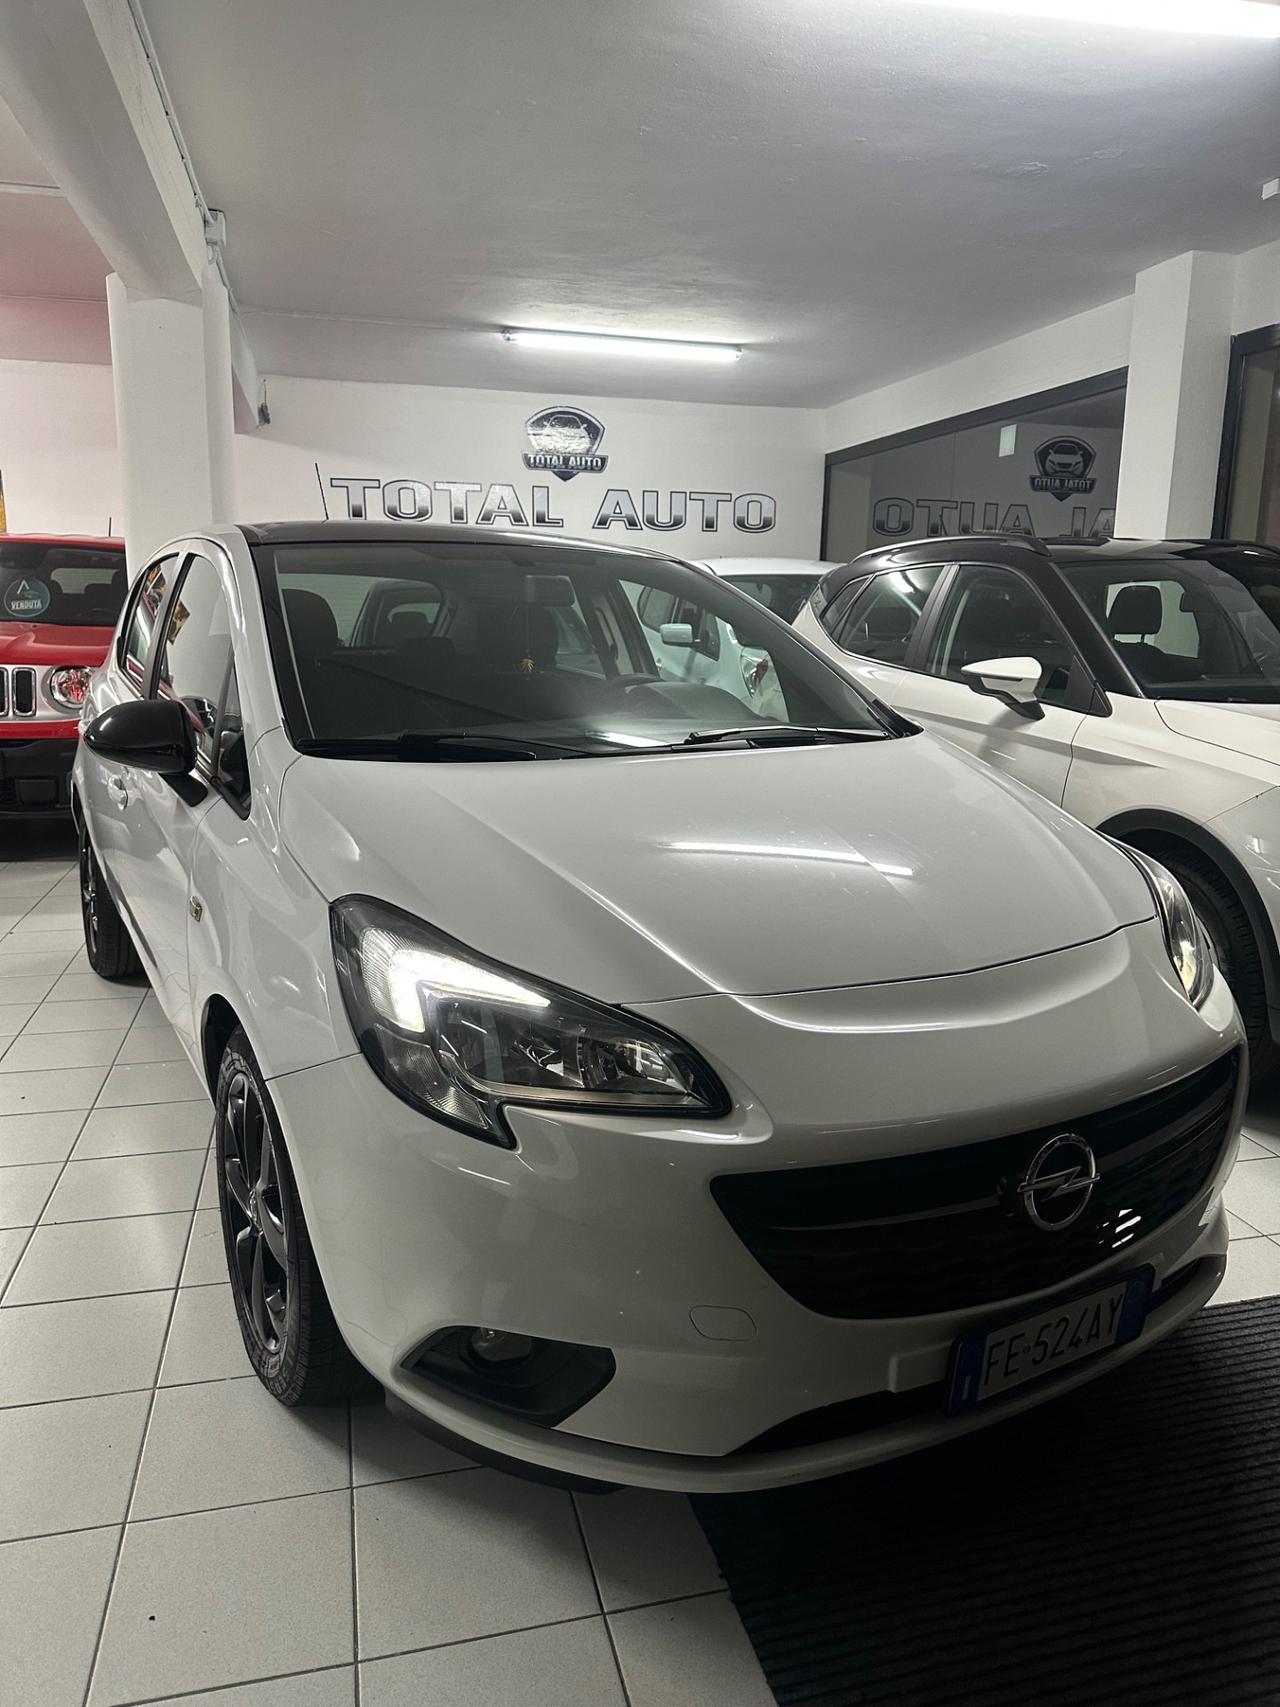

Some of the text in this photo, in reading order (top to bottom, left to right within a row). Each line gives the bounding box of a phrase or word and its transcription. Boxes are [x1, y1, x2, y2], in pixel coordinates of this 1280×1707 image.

[527, 454, 602, 470] TOTAL AUTO
[330, 478, 777, 534] TOTAL AUTO
[11, 599, 42, 610] VENDUTA
